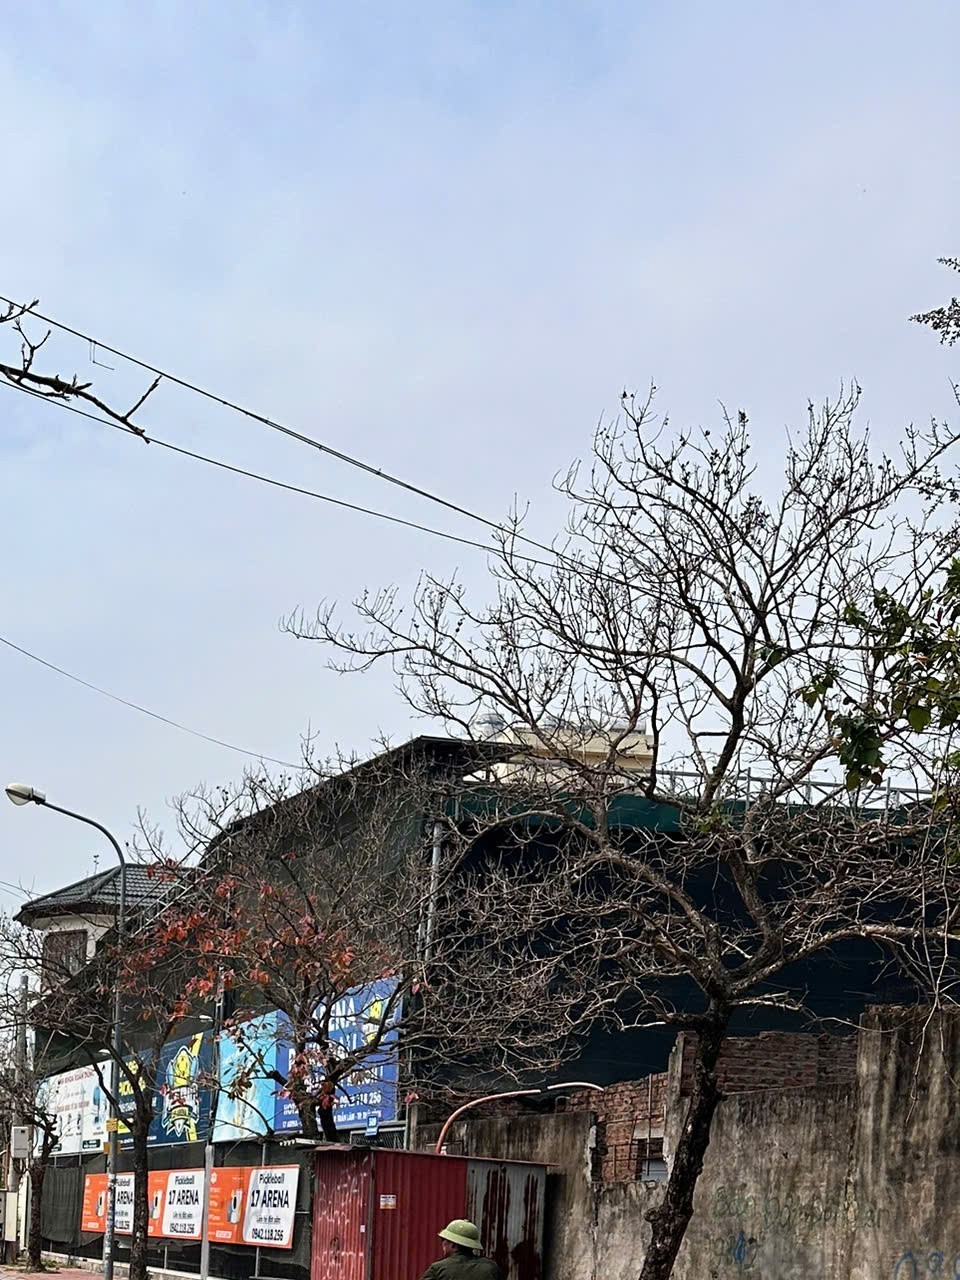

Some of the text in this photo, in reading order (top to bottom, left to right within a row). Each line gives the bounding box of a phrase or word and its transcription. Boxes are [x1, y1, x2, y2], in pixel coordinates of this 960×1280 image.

[116, 1191, 134, 1204] ARENA
[168, 1190, 200, 1205] 17 ARENA
[251, 1190, 289, 1208] 17 ARENA
